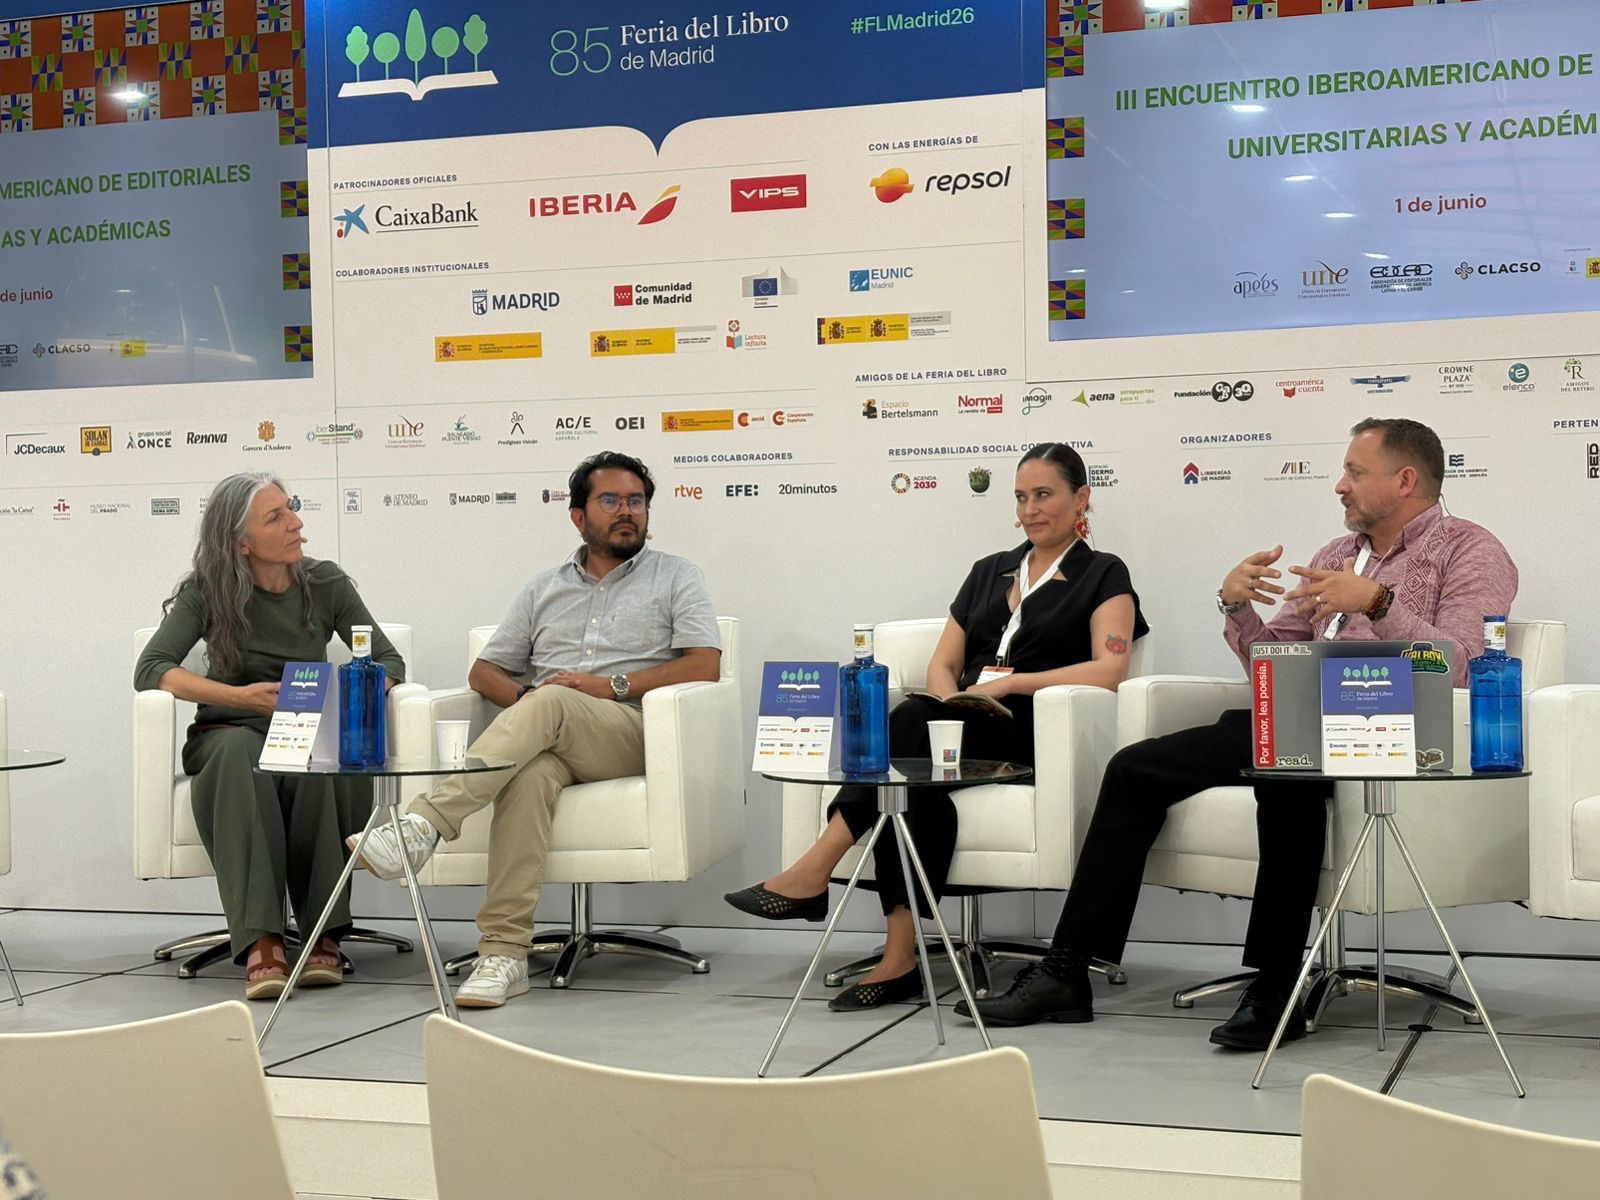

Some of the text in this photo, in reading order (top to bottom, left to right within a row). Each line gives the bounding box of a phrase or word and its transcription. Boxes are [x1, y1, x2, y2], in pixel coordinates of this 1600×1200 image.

[850, 8, 975, 34] #FLMadrid26
[620, 11, 789, 46] Feria del Libro
[549, 26, 612, 76] 85
[620, 45, 715, 71] de Madrid
[1115, 53, 1593, 110] III ENCUENTRO IBEROAMERICANO DE
[1228, 109, 1597, 159] UNIVERSITARIAS Y ACADÉM
[868, 136, 979, 151] CON LAS ENERGÍAS DE
[100, 174, 122, 192] DE
[127, 164, 251, 190] EDITORIALES
[334, 174, 457, 190] PATROCINADORES OFICIALES
[925, 166, 1012, 195] repsol
[738, 186, 799, 199] VIPS
[529, 191, 637, 218] IBERIA
[1395, 194, 1486, 215] 1 de junio
[375, 201, 479, 227] CaixaBank
[1, 219, 171, 248] AS Y ACADÉMICAS
[336, 262, 489, 277] COLABORADORES INSTITUCIONALES
[871, 267, 913, 280] EUNIC
[1478, 262, 1541, 275] CLACSO
[635, 282, 692, 293] Comunidad
[871, 281, 894, 289] Madrid
[0, 288, 53, 304] de junio
[492, 291, 560, 311] MADRID
[635, 293, 692, 305] de Madrid
[48, 344, 91, 354] CLACSO
[855, 368, 1007, 382] AMIGOS DE LA FERIA DEL LIBRO
[1438, 365, 1474, 374] CROWNE
[1571, 366, 1585, 379] R
[1275, 379, 1324, 387] centroamérica
[1298, 385, 1324, 393] cuenta
[1502, 383, 1535, 391] elenco
[958, 394, 1002, 407] Normal
[1023, 394, 1052, 403] imagin
[1089, 393, 1115, 401] aena
[1174, 390, 1211, 398] Fundación
[881, 400, 910, 410] Espacio
[881, 409, 938, 418] Bertelsmann
[555, 416, 591, 429] AC/E
[615, 416, 645, 430] OEI
[1553, 419, 1598, 428] PERTEN
[84, 431, 108, 441] SOLAN
[186, 431, 228, 444] Renova
[1180, 433, 1272, 444] ORGANIZADORES
[14, 444, 66, 455] JCDecaux
[138, 438, 172, 449] ONCE
[888, 445, 979, 456] RESPONSABILIDAD
[982, 444, 1018, 453] SOCIAL
[673, 452, 793, 464] MEDIOS COLABORADORES
[1589, 443, 1599, 479] RED
[674, 484, 702, 499] rtve
[778, 483, 837, 495] 20minutos
[913, 481, 937, 490] 2030
[458, 495, 490, 504] MADRID
[1340, 691, 1355, 701] 85
[1257, 662, 1270, 764] Por favor, lea poesía.
[1278, 755, 1313, 766] read.
